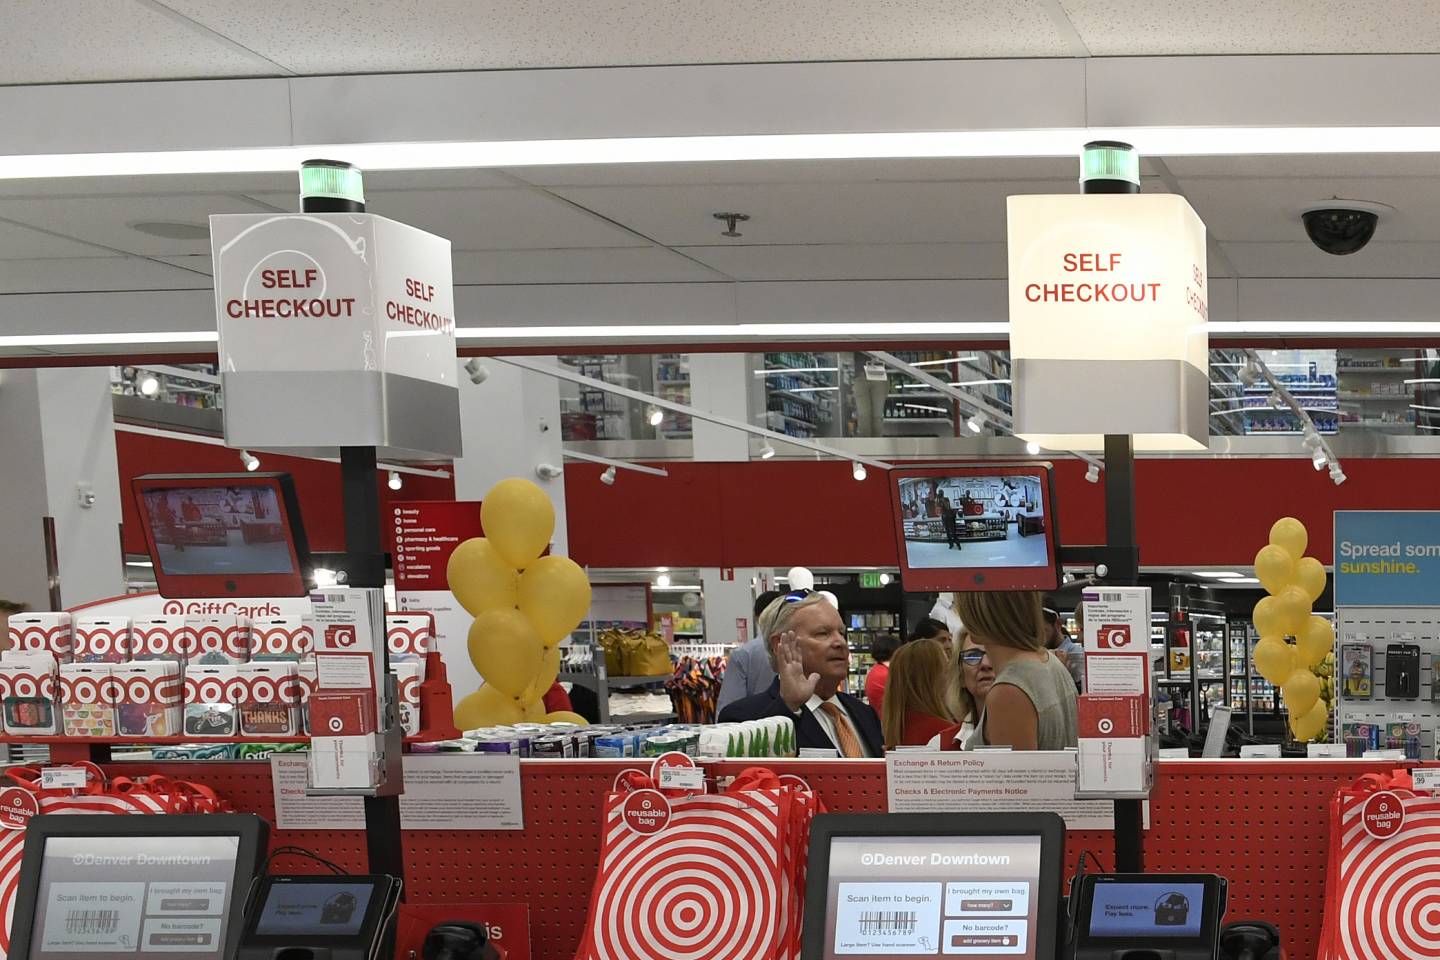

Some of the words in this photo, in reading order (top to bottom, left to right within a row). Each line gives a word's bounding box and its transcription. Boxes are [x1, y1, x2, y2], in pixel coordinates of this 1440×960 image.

[1063, 253, 1121, 272] SELF
[262, 270, 317, 289] SELF
[406, 279, 434, 302] SELF
[1025, 284, 1161, 302] CHECKOUT
[226, 298, 355, 319] CHECKOUT
[386, 302, 453, 337] CHECKOUT
[1340, 542, 1401, 559] Spread
[1340, 560, 1420, 573] sunshine.
[186, 602, 281, 618] GiftCards
[242, 710, 287, 725] THANKS
[968, 788, 1003, 796] Payments
[0, 805, 34, 817] reusable
[1367, 812, 1401, 821] reusable
[9, 813, 24, 824] bag
[638, 817, 656, 827] bag
[1376, 820, 1392, 829] bag
[85, 854, 132, 865] Denver
[137, 854, 210, 865] Downtown
[874, 854, 926, 865] Denver
[931, 854, 1010, 865] Downtown
[952, 888, 980, 896] brought
[847, 895, 869, 903] Scan
[872, 895, 892, 903] item
[894, 895, 903, 903] to
[905, 895, 932, 904] begin.
